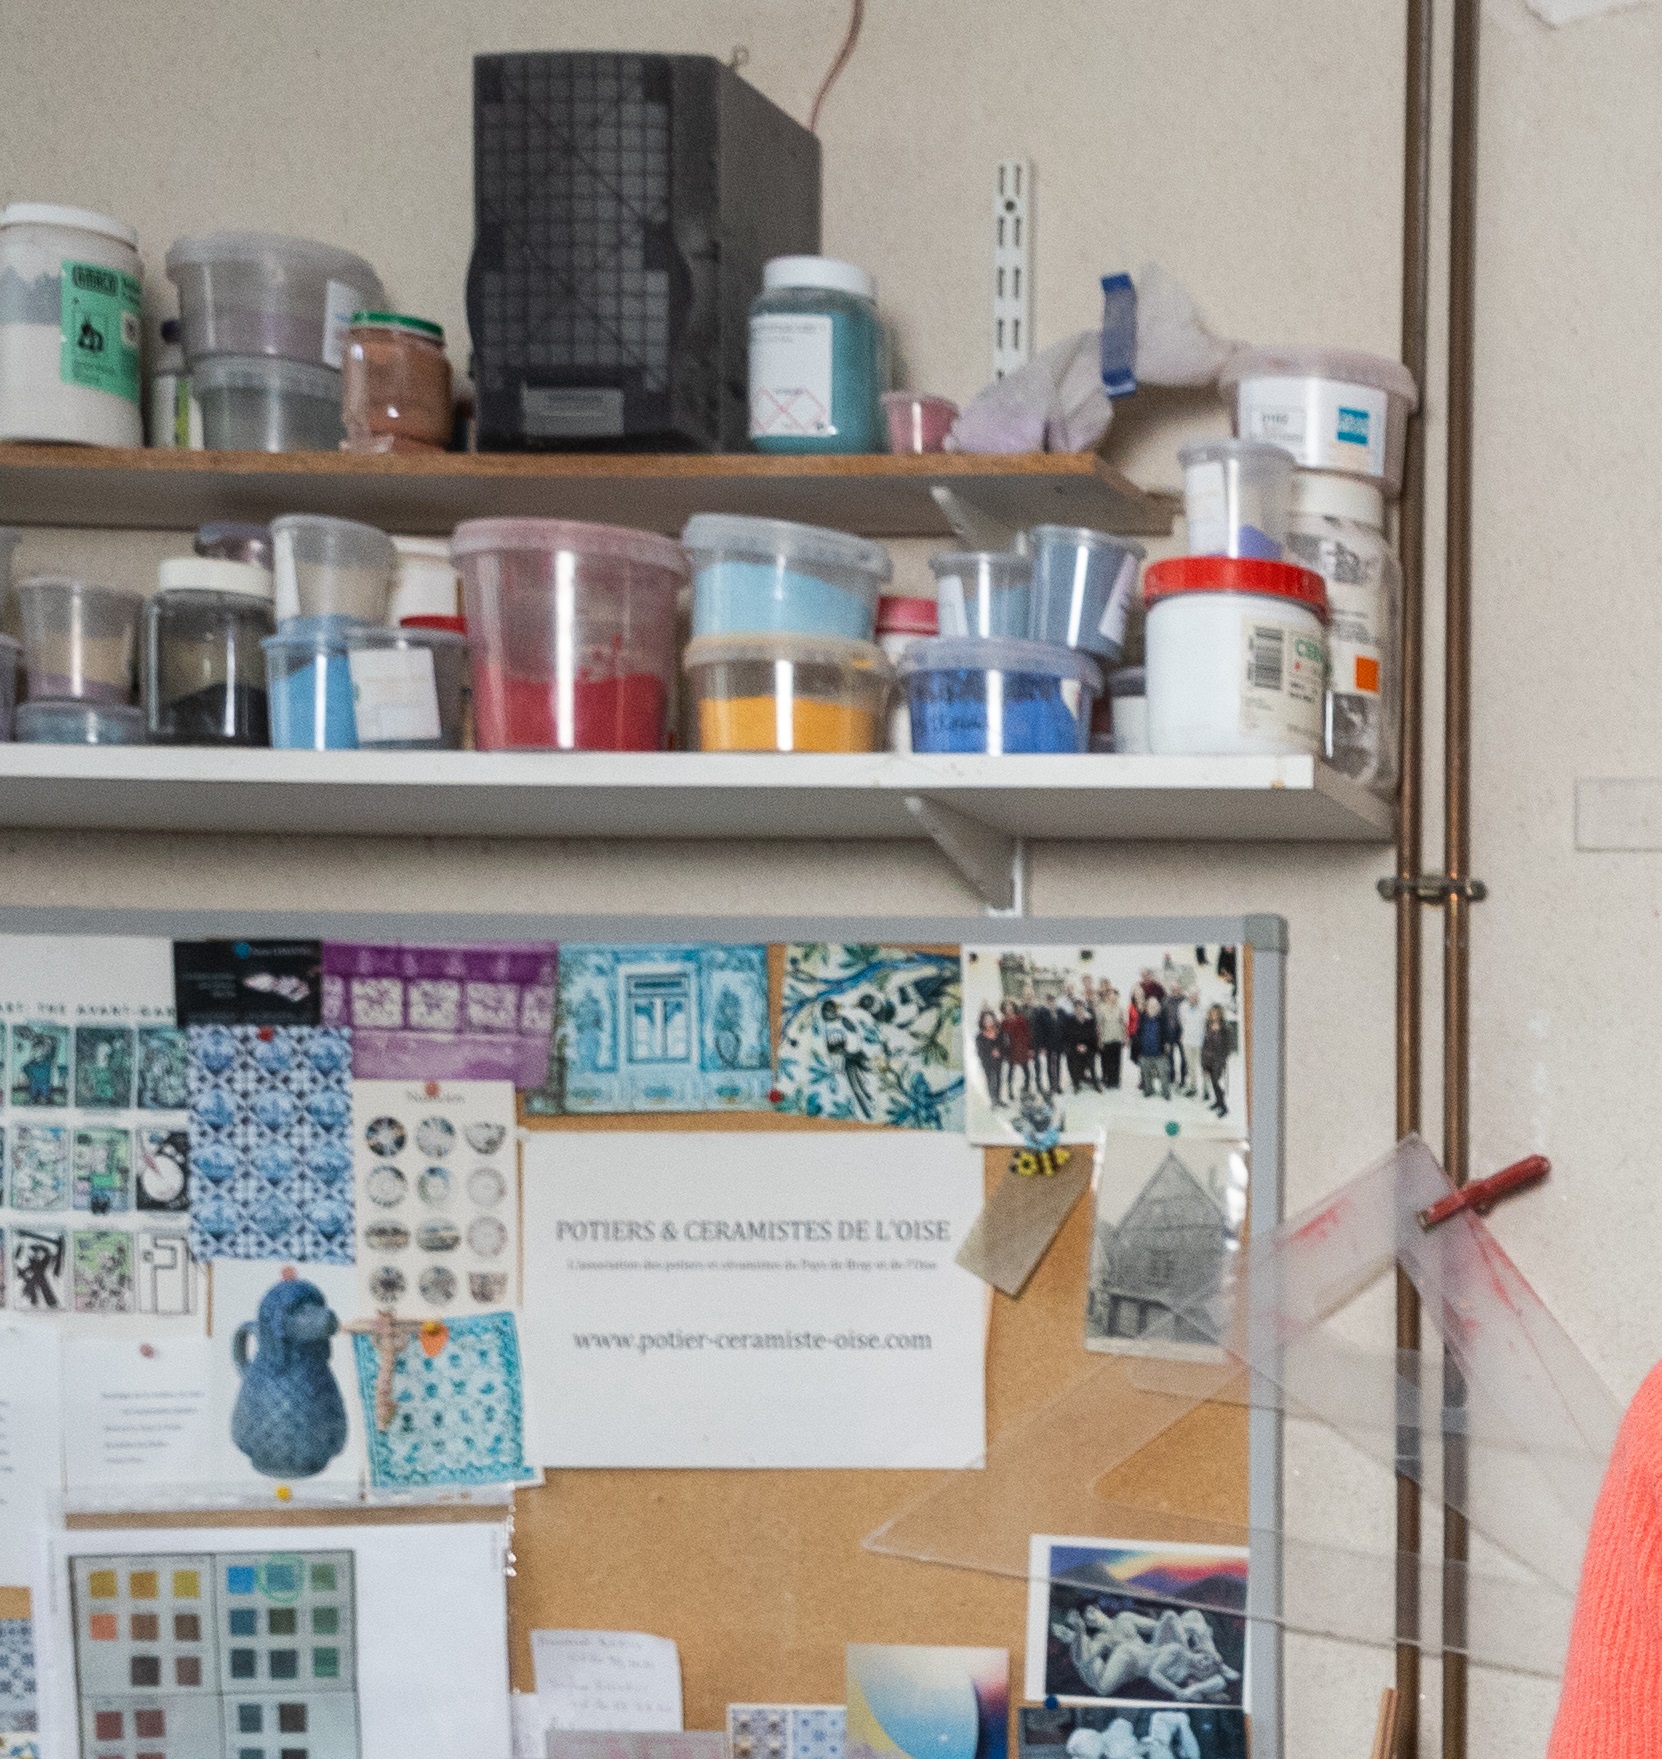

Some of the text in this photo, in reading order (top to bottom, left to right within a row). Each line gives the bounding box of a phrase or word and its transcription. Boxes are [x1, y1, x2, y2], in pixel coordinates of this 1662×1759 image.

[555, 1218, 951, 1242] POTIERS & CERAMISTES DE L'OISE
[572, 1327, 933, 1356] www.potier-ceramiste-oise.com
